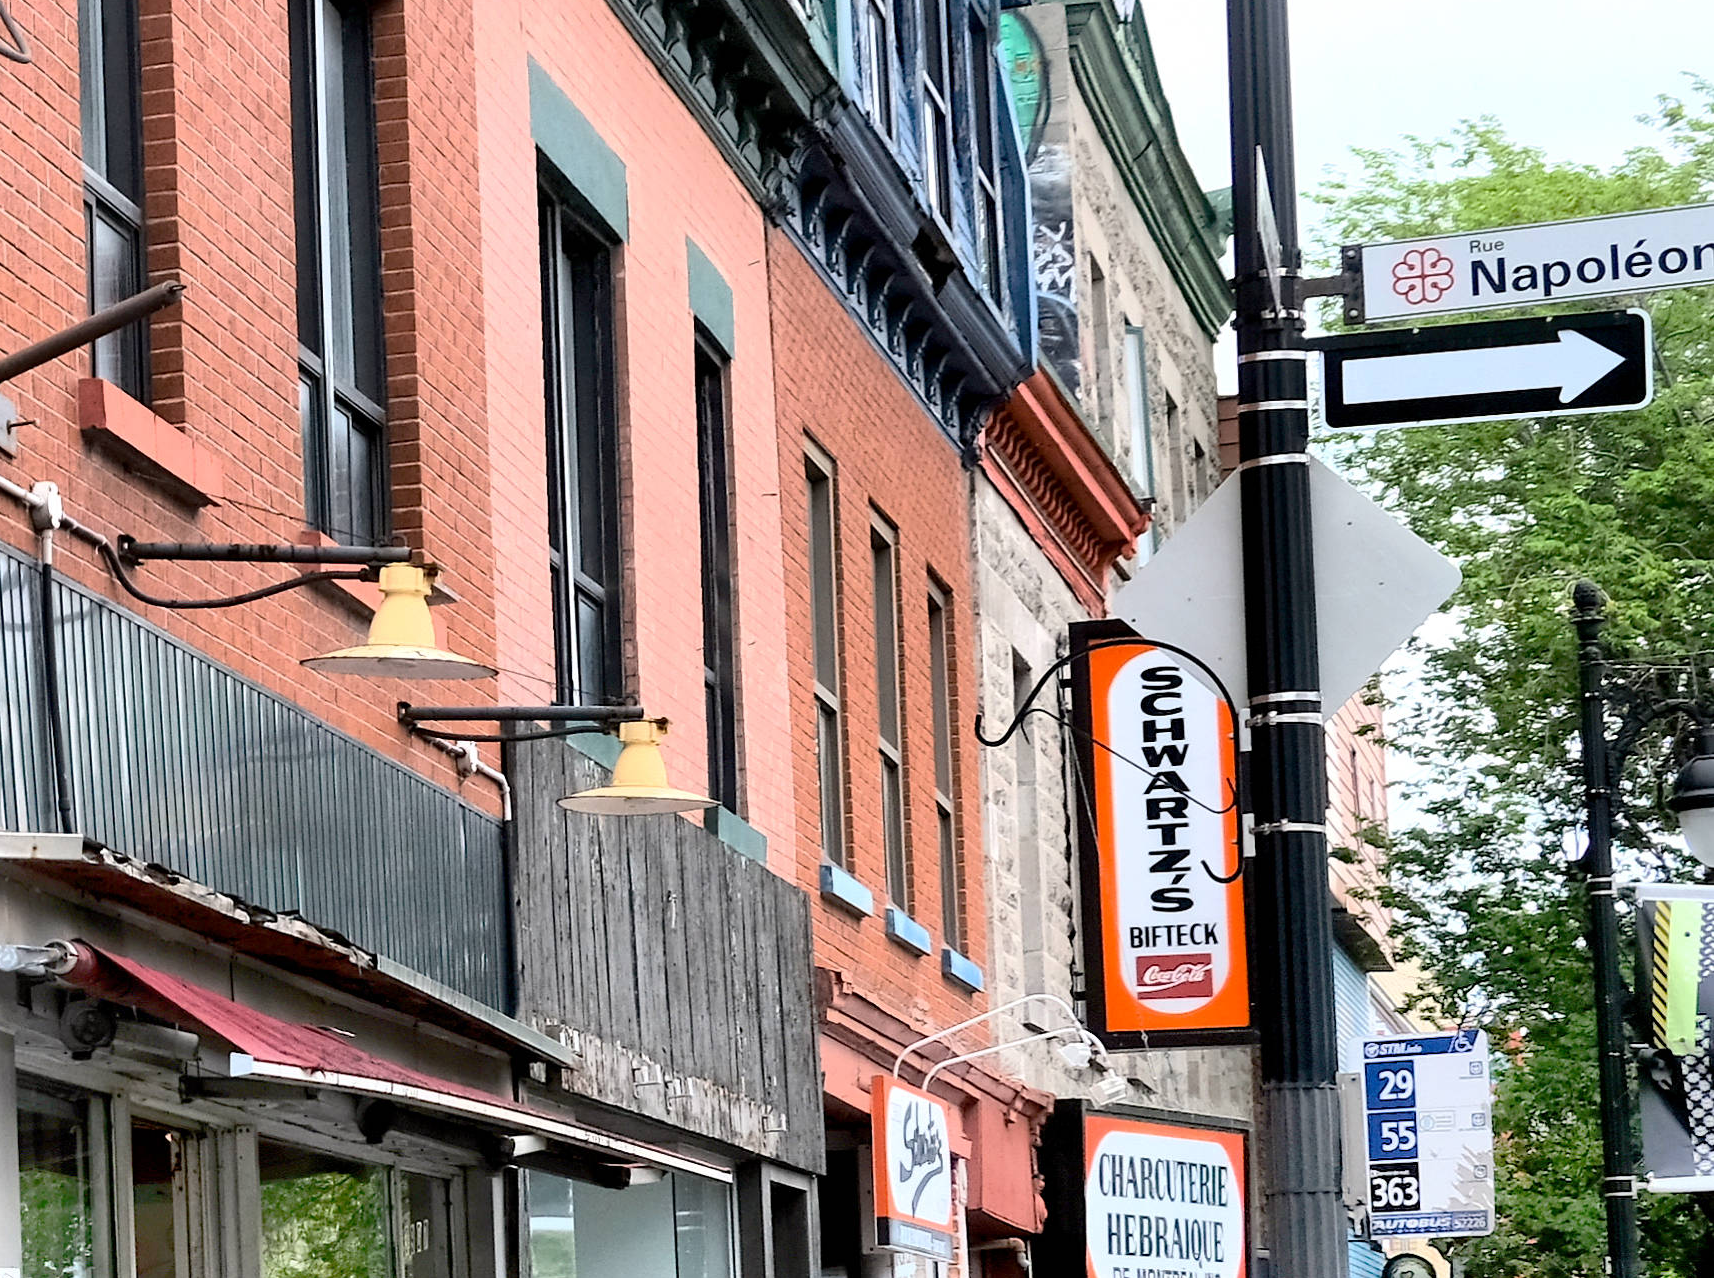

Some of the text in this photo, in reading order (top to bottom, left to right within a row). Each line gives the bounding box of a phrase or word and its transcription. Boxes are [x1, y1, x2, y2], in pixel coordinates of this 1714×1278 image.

[1469, 240, 1505, 254] Rue
[1471, 239, 1714, 297] Napoléon
[1140, 666, 1194, 913] SCHWARTZ'S
[1129, 923, 1219, 949] BIFTECK
[1378, 1069, 1414, 1101] 29
[1381, 1121, 1417, 1152] 55
[1098, 1153, 1229, 1207] CHARCUTERIE
[1371, 1176, 1419, 1208] 363
[1372, 1217, 1452, 1230] AUTOBUS
[1107, 1213, 1225, 1268] HEBRAIQUE
